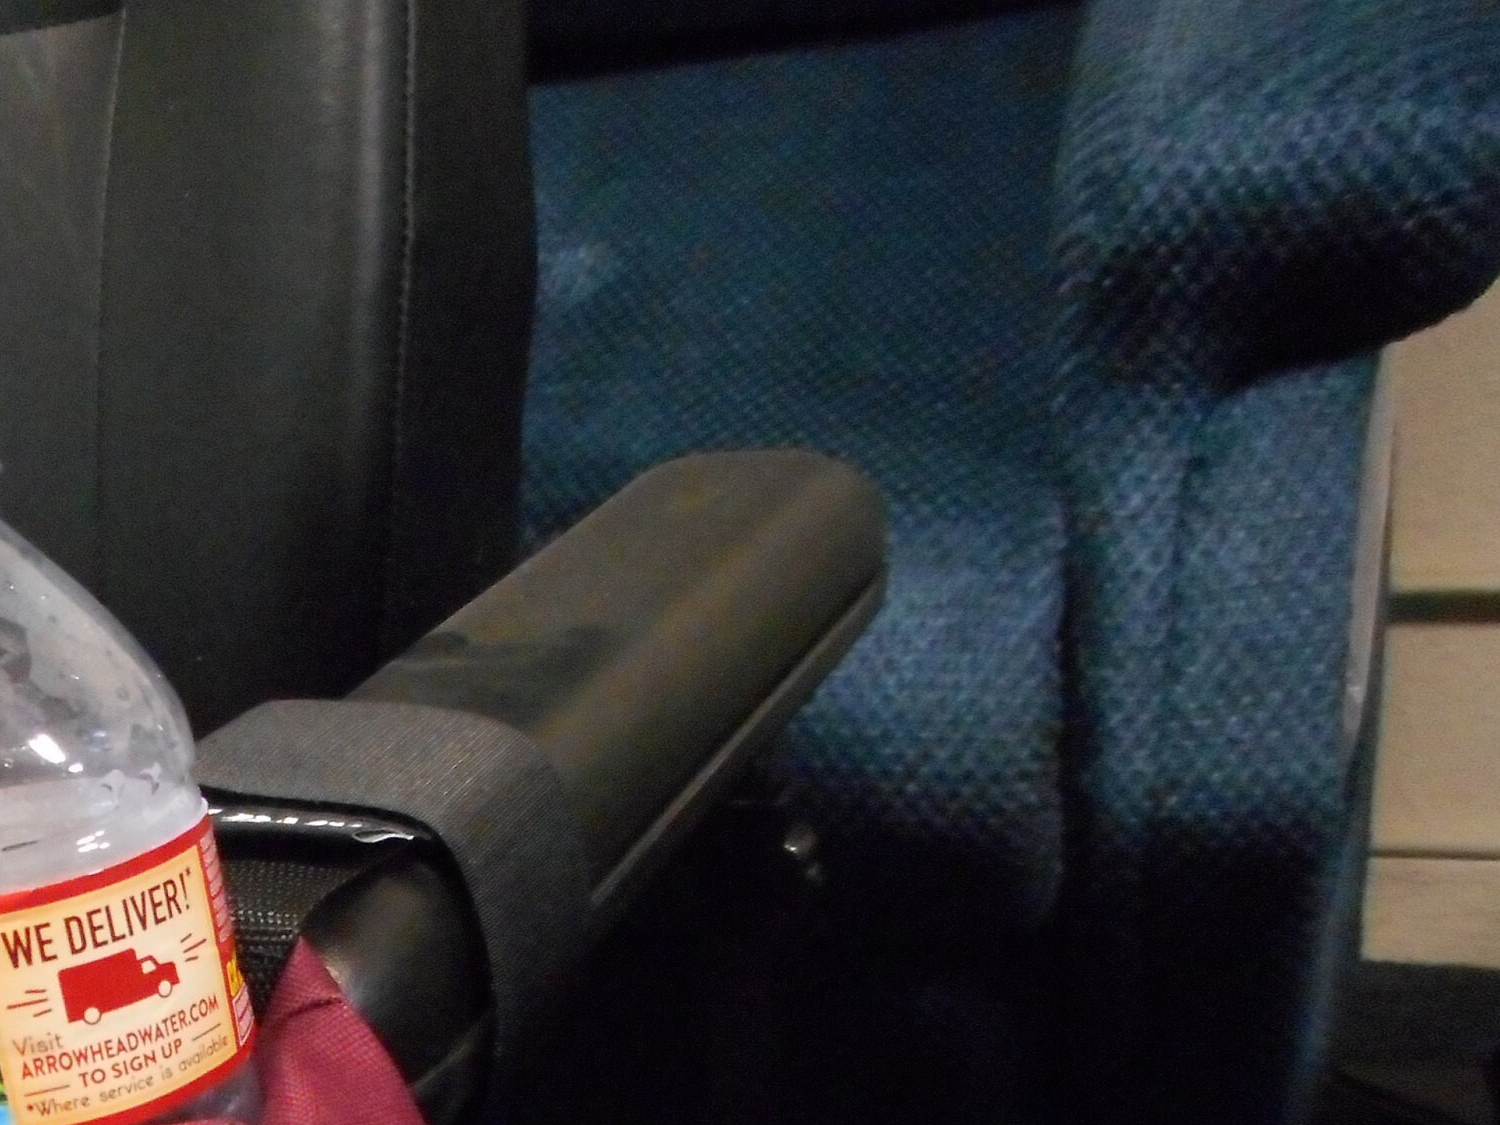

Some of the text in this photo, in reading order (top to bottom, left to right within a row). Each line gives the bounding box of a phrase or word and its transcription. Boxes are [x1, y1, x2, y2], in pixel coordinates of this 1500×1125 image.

[0, 922, 58, 969] WE
[12, 1031, 64, 1057] Visit
[21, 994, 219, 1080] ARROWHEADWATER.COM
[78, 1038, 183, 1088] TO SIGN UP
[100, 1075, 154, 1103] service
[161, 1065, 174, 1081] is
[178, 1034, 229, 1073] available
